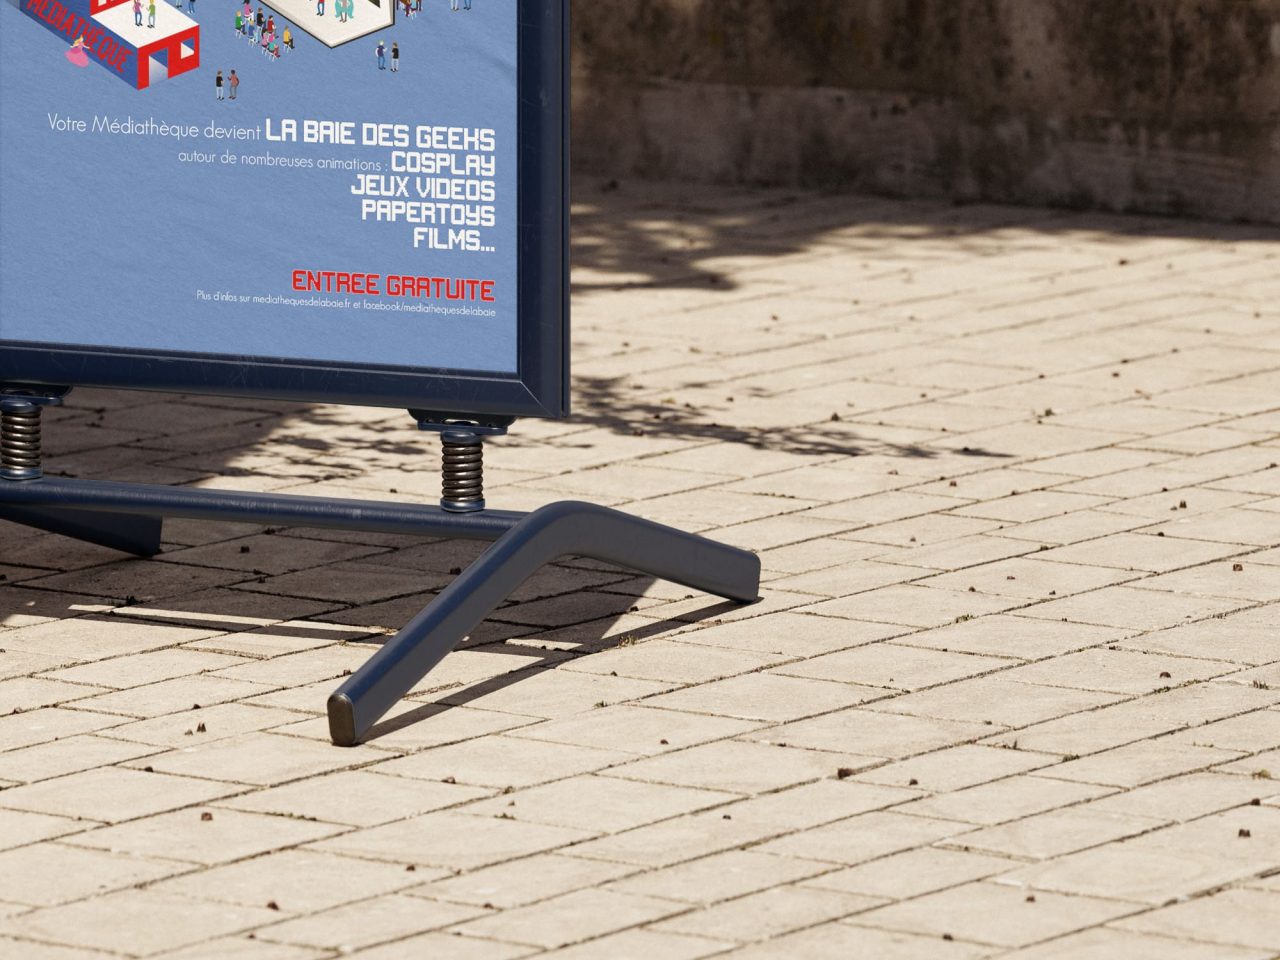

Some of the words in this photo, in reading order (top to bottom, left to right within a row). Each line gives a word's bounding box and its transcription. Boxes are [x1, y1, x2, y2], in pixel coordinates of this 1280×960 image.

[47, 112, 87, 132] Votre
[92, 115, 199, 140] Médiathèque
[204, 120, 261, 140] devient
[266, 118, 297, 142] LA
[303, 120, 356, 145] BAIE
[362, 122, 410, 148] DES
[415, 125, 496, 152] GEEKS
[178, 150, 216, 163] autour
[220, 149, 237, 164] de
[241, 152, 314, 168] nombreuses
[316, 157, 382, 172] animations
[391, 150, 496, 177] COSPLAY
[351, 173, 410, 198] JEUX
[415, 176, 496, 202] VIDEOS
[361, 199, 496, 227] PAPERTOYS
[413, 226, 496, 252] FILMS...
[291, 269, 380, 296] ENTREE
[386, 275, 496, 303] GRATUITE
[196, 290, 211, 301] Plus
[213, 291, 238, 303] d'infos
[252, 293, 351, 309] mediathequesdelabaie.fr
[352, 300, 361, 309] et
[362, 299, 497, 318] facebook/mediathequesdelabaie
